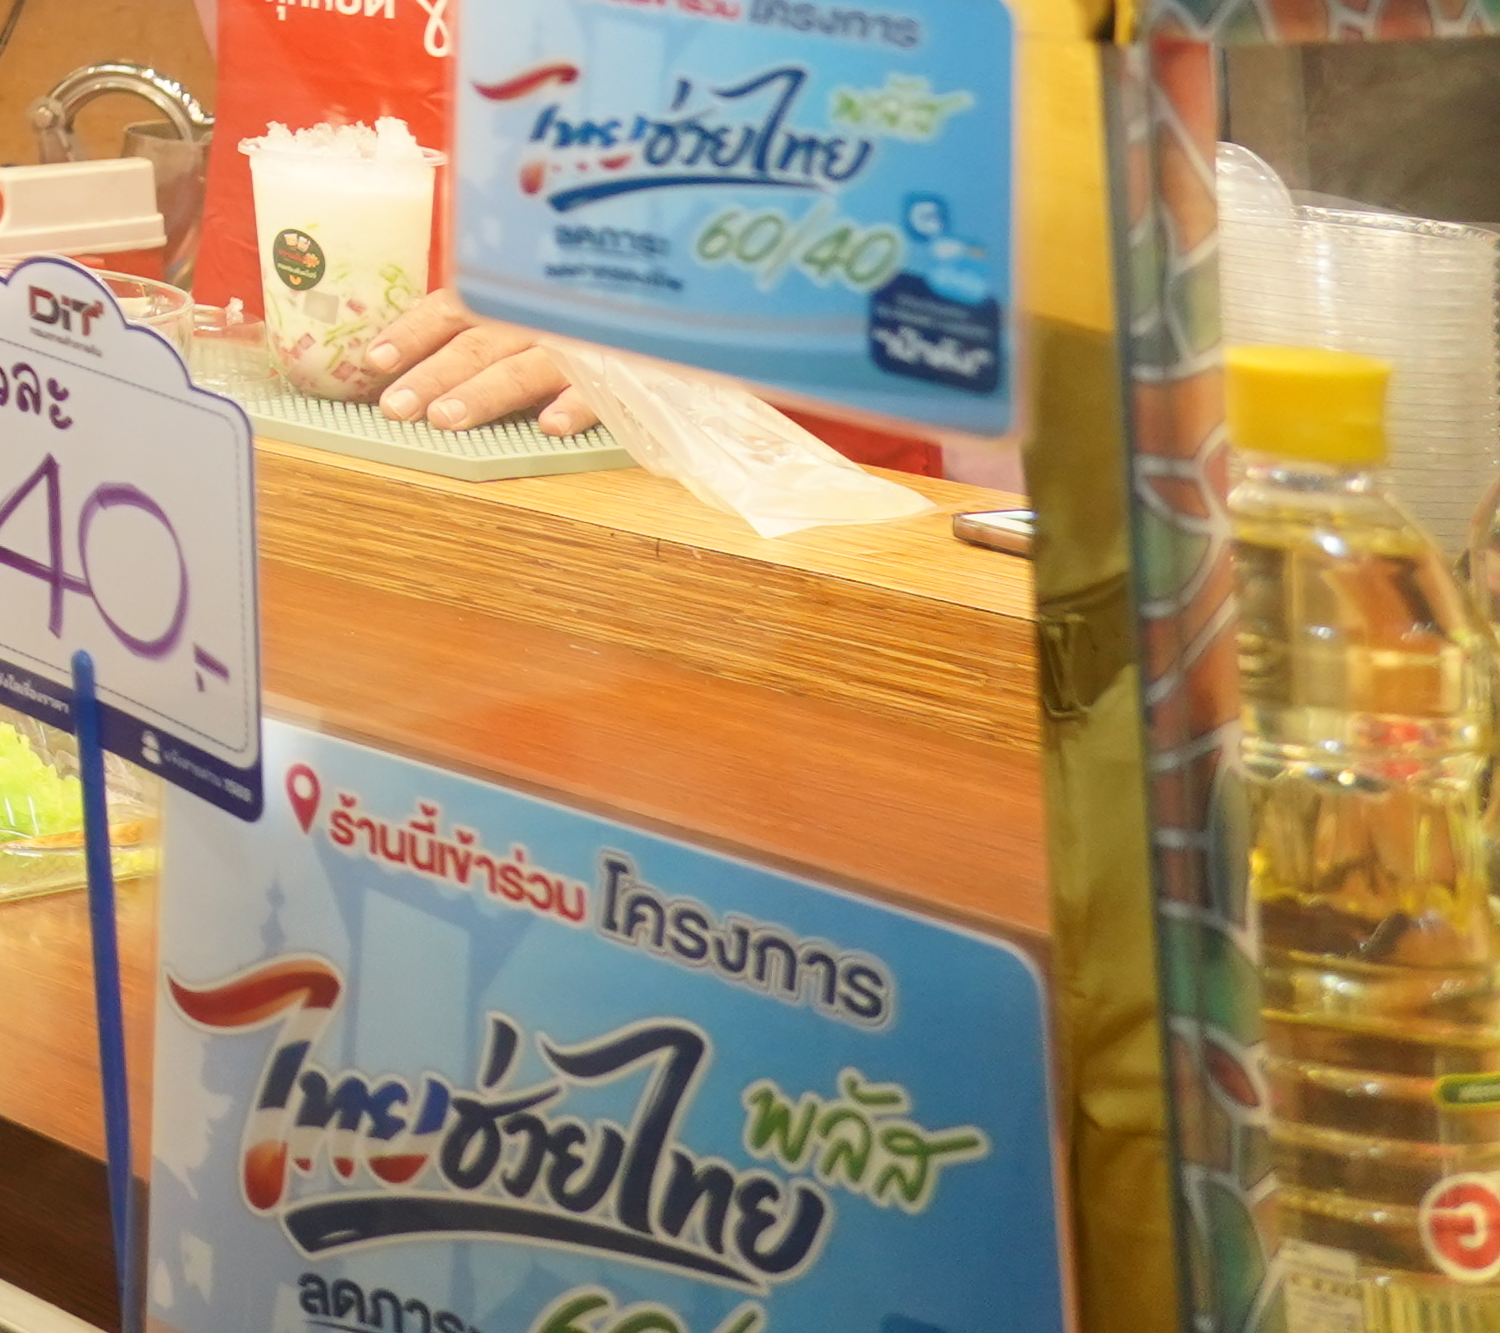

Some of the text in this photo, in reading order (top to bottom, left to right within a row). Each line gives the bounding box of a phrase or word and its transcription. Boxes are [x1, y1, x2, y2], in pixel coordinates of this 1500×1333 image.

[696, 203, 903, 293] 60/40
[328, 793, 891, 1026] ร้านนี้เข้าร่วม โครงการ
[166, 953, 987, 1279] ไทยช่วยไทย พลัส
[297, 1272, 482, 1333] ลดภาร
